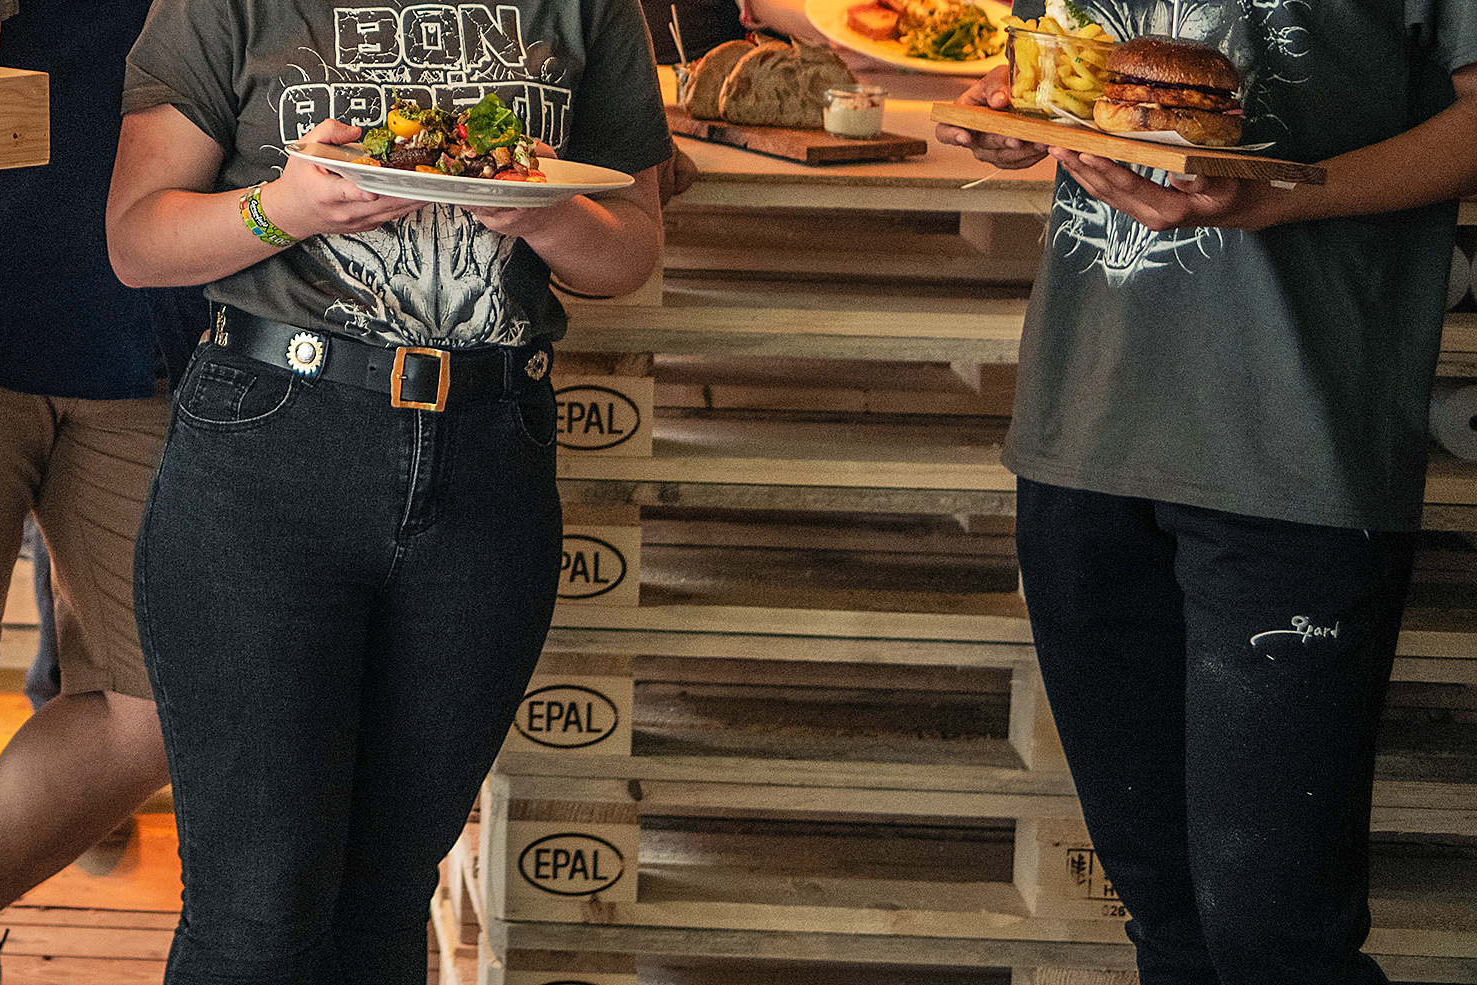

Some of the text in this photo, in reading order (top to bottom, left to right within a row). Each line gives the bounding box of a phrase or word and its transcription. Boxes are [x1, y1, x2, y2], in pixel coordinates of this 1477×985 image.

[334, 4, 526, 72] BON
[562, 551, 609, 583] PAL
[528, 701, 602, 733] EPAL
[535, 848, 608, 880] EPAL
